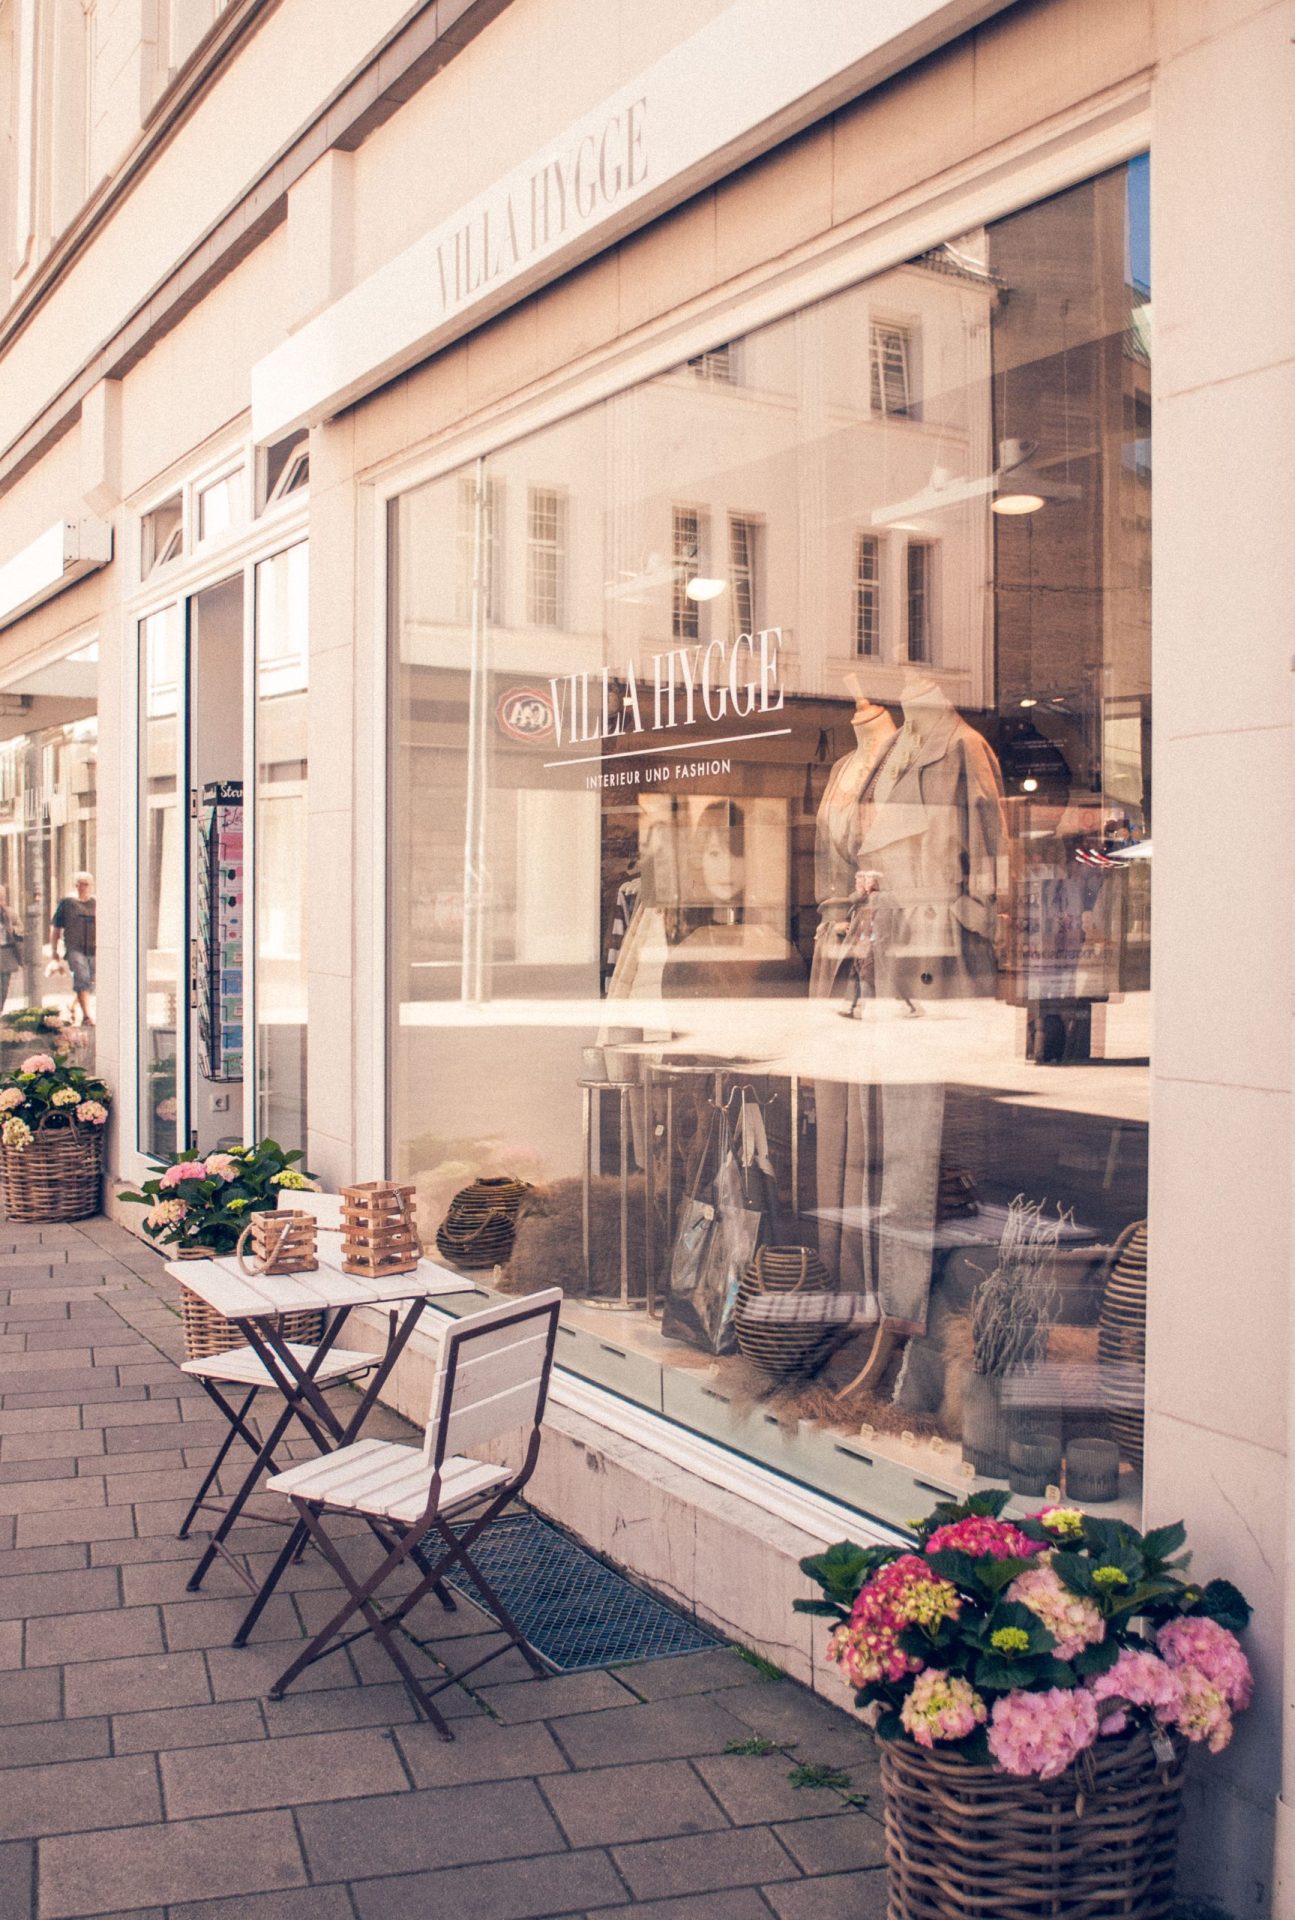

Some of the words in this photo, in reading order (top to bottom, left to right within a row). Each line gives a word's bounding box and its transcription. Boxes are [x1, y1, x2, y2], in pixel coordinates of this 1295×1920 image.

[437, 191, 521, 313] VILLA
[530, 96, 648, 253] HYGGE
[548, 658, 646, 748] VILLA
[652, 627, 785, 731] HYGGE
[586, 770, 641, 789] INTERIEUR
[645, 767, 670, 782] UND
[675, 759, 731, 779] FASHION
